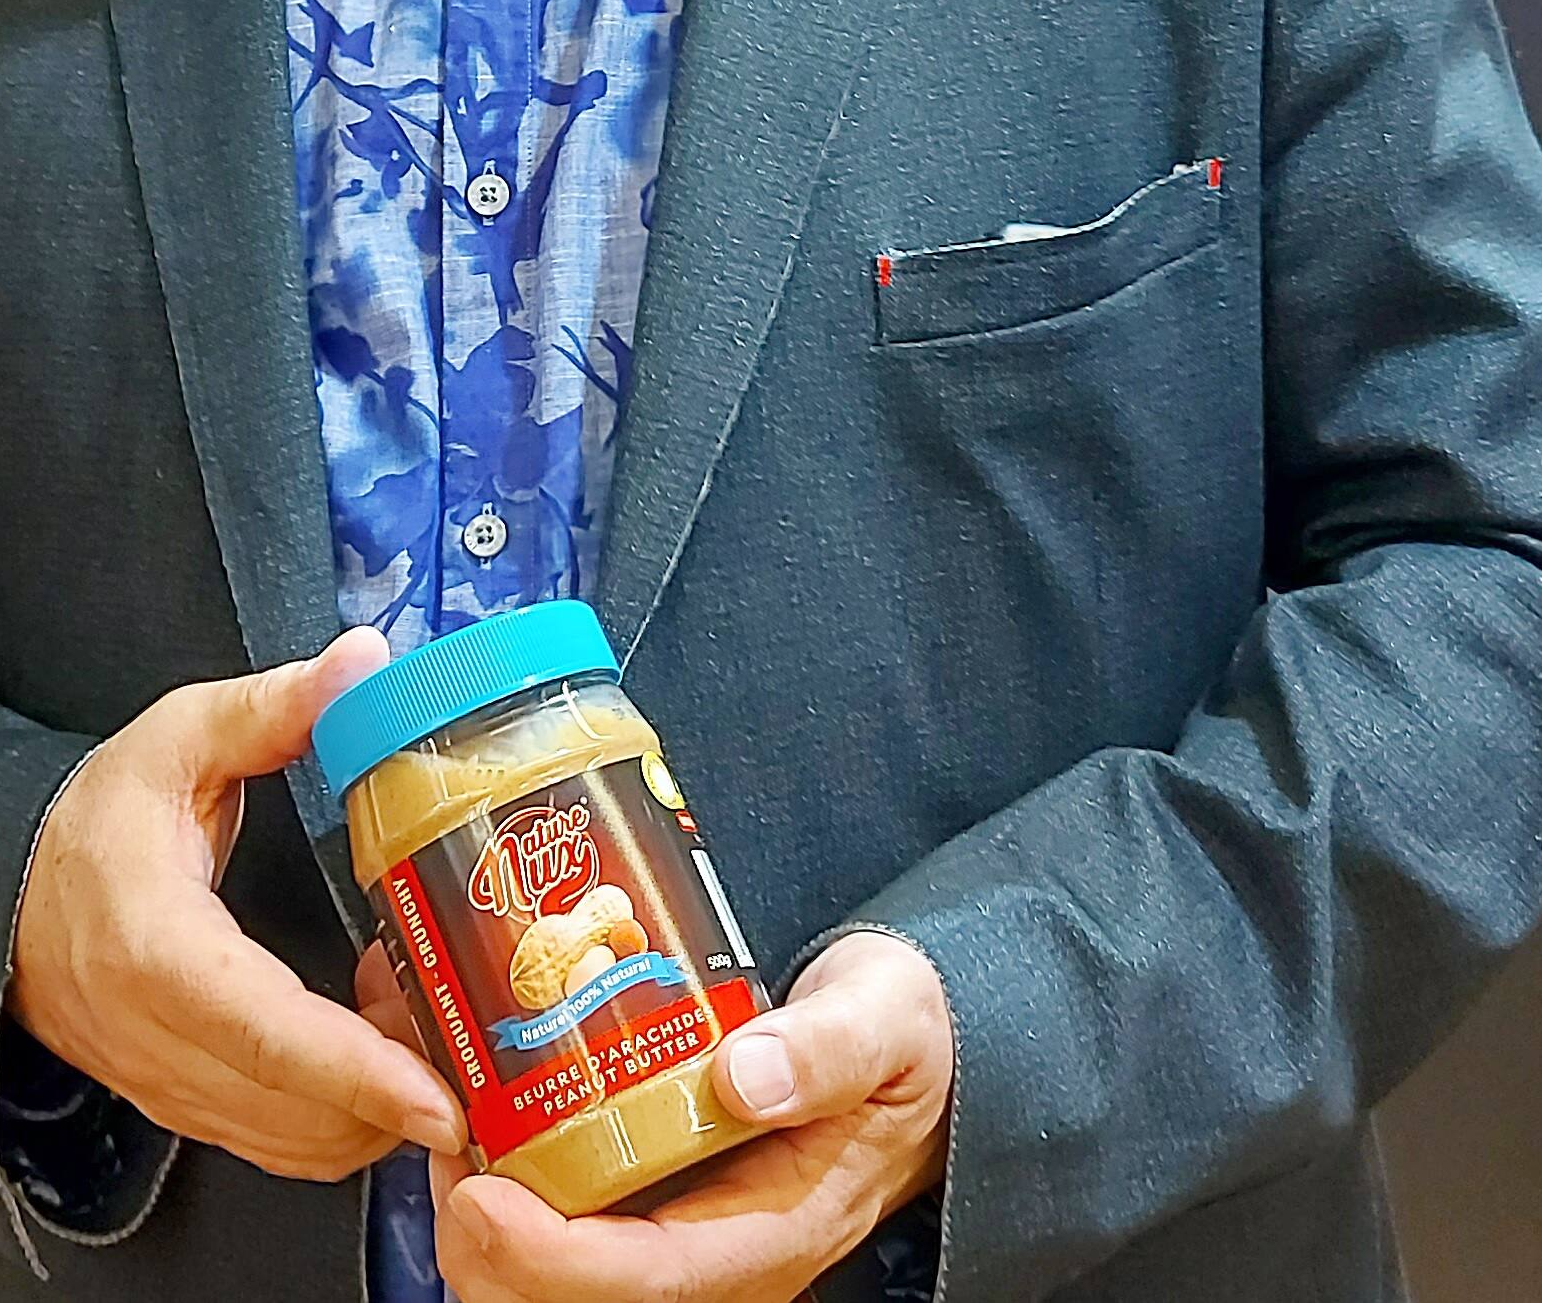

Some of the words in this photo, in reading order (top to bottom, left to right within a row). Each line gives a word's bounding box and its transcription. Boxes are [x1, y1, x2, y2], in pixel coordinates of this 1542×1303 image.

[392, 877, 438, 969] CRUNCHY
[569, 983, 603, 1016] 100%
[601, 957, 652, 992] Natural
[433, 982, 486, 1090] CROQUANT
[543, 1067, 619, 1116] PEANUT
[625, 1032, 700, 1075] BUTTER
[513, 1063, 583, 1111] BEURRE
